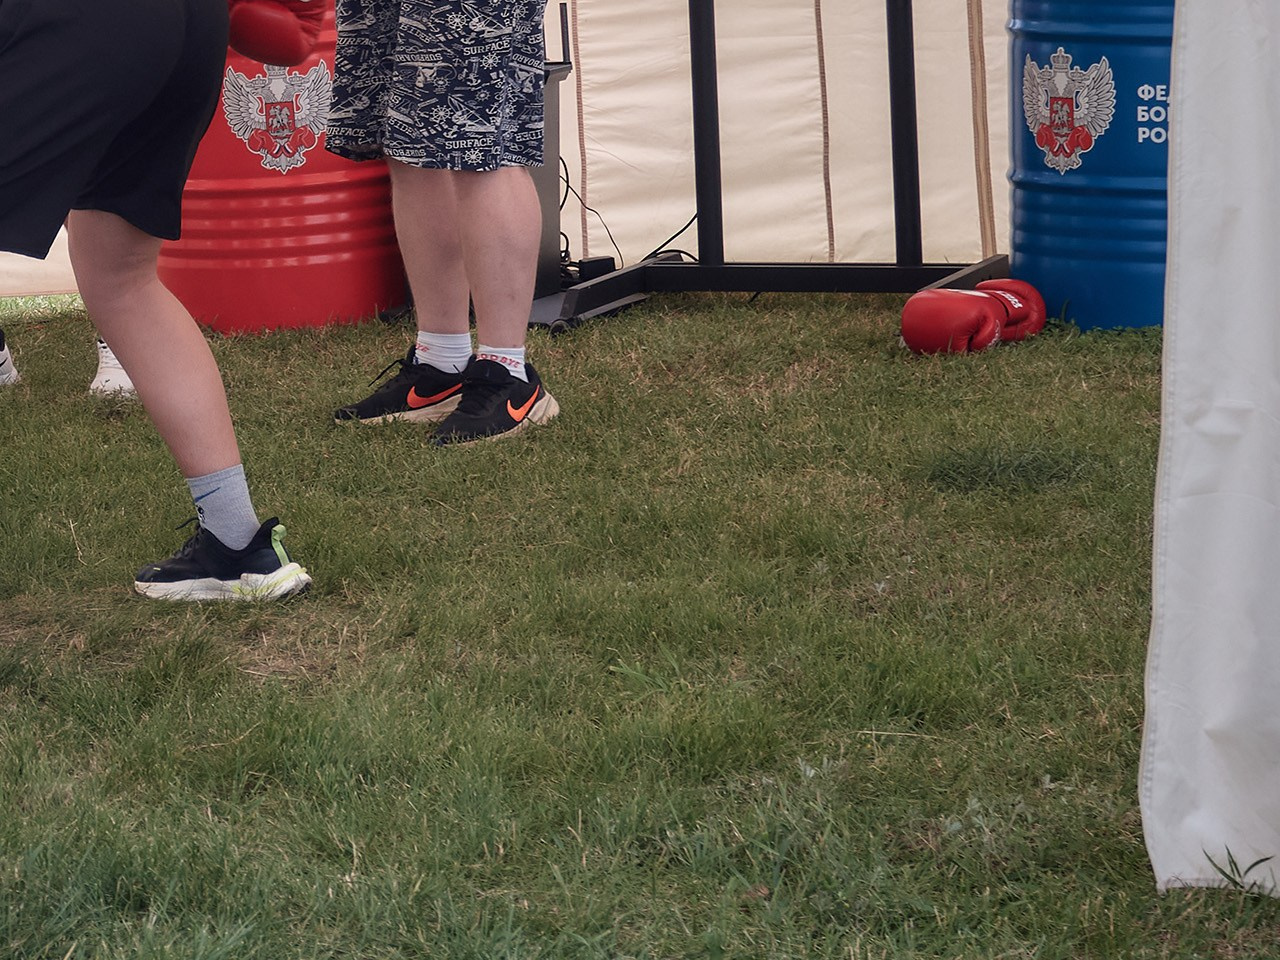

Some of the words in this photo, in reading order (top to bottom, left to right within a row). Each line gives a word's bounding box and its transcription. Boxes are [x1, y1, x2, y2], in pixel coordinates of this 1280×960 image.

[464, 40, 510, 56] SURFACE
[1137, 84, 1171, 102] ФЕ
[1137, 106, 1170, 122] БО
[326, 127, 367, 137] URFACE
[1137, 127, 1169, 143] РО
[445, 137, 493, 150] SURFACE
[477, 353, 520, 368] ODBYE
